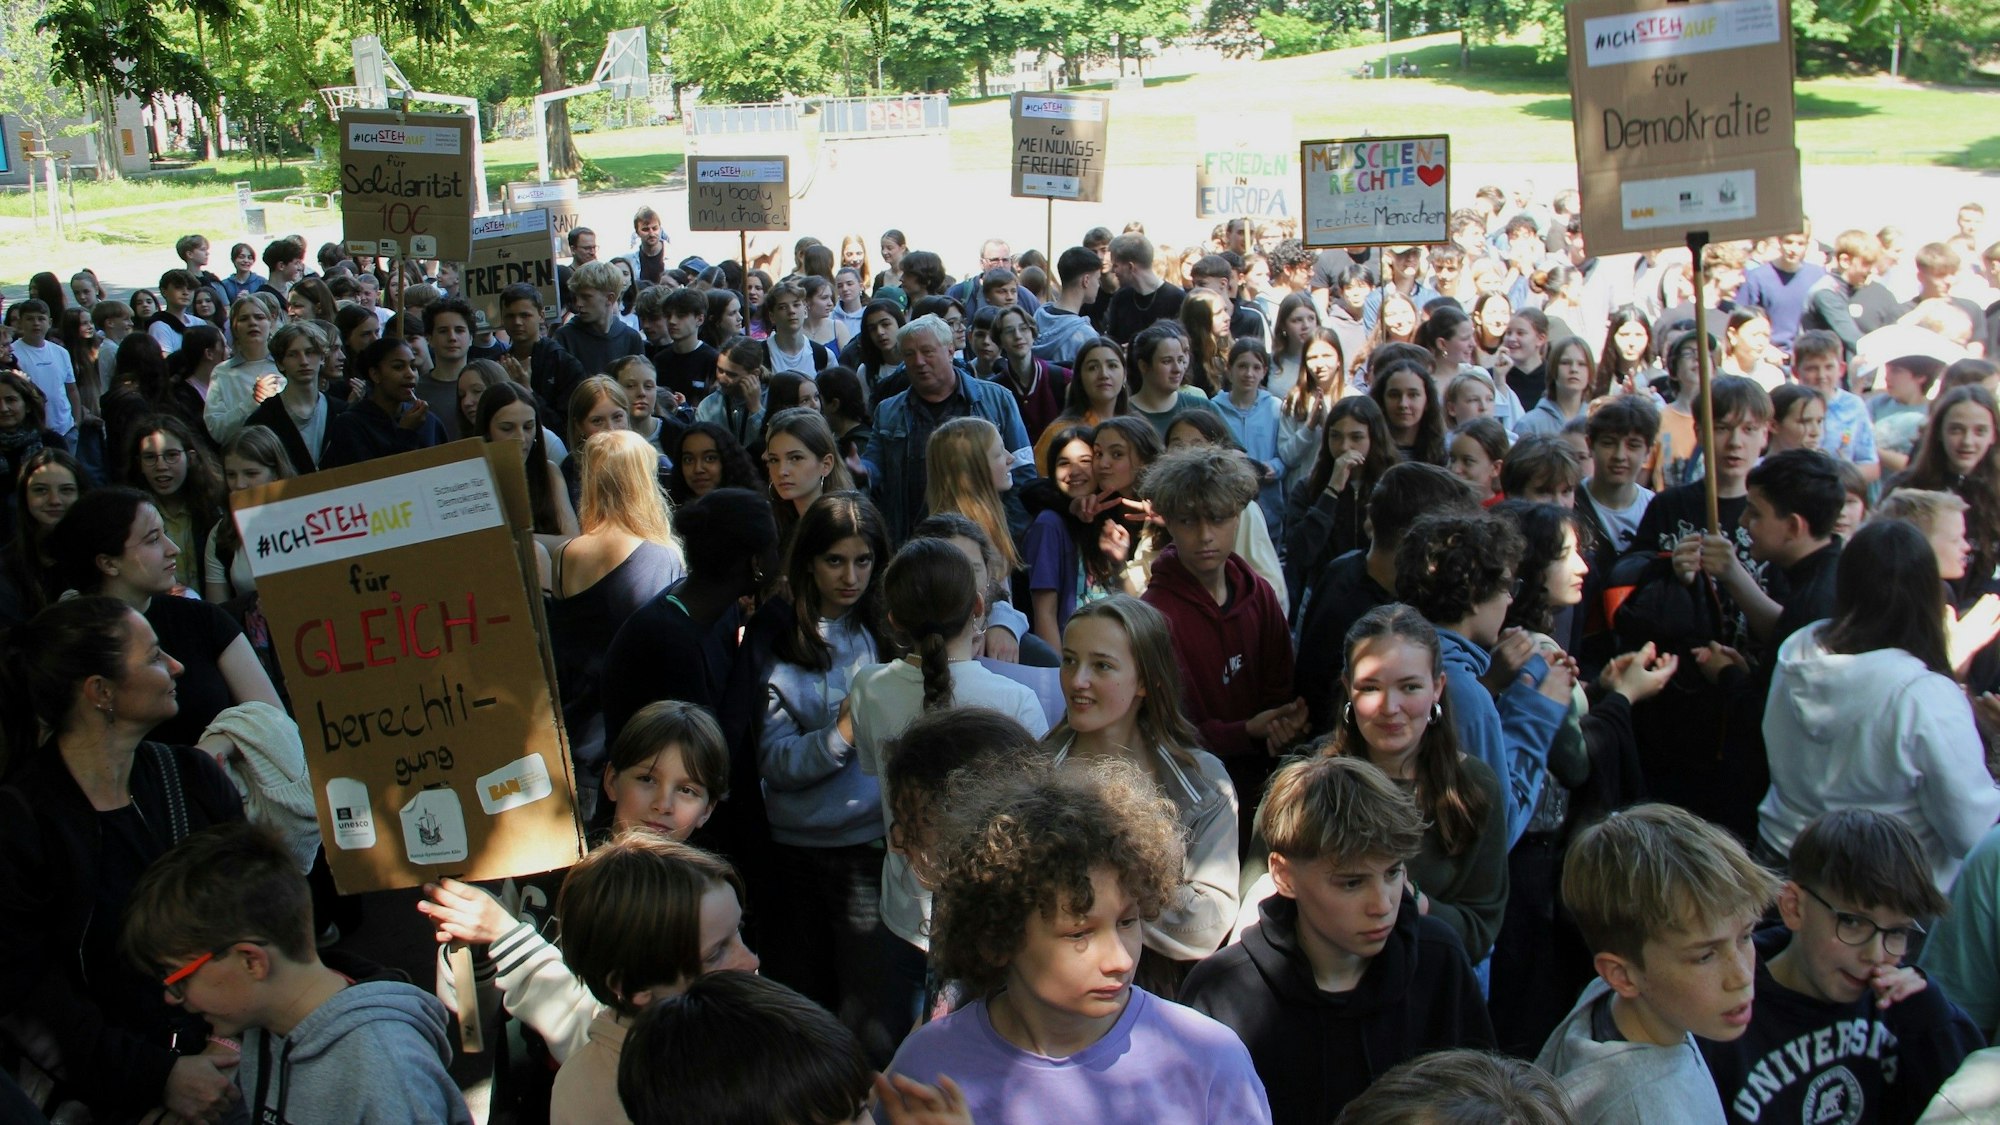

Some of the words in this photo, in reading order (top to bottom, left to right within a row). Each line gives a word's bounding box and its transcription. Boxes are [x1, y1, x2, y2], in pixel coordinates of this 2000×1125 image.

[1654, 64, 1688, 88] für
[1603, 92, 1771, 152] Demokratie
[386, 154, 406, 167] für
[1018, 138, 1102, 157] MEINUNGS-
[1311, 142, 1443, 172] MENSCHEN-
[1020, 155, 1091, 177] FREIHEIT
[1204, 152, 1288, 176] FRIEDEN
[343, 163, 463, 199] Solidarität
[1234, 176, 1247, 185] IN
[1329, 166, 1415, 195] RECHTE
[700, 184, 722, 206] my
[728, 184, 773, 210] body
[1201, 186, 1287, 217] EUROPA
[377, 202, 430, 235] 10C
[698, 208, 725, 229] my
[731, 204, 788, 227] choice!
[1315, 209, 1369, 229] rechte
[1374, 199, 1446, 226] Menschen
[465, 258, 553, 299] FRIEDEN
[349, 563, 390, 594] für
[317, 674, 497, 754] berechti-
[395, 745, 455, 787] gung
[338, 819, 369, 830] unesco
